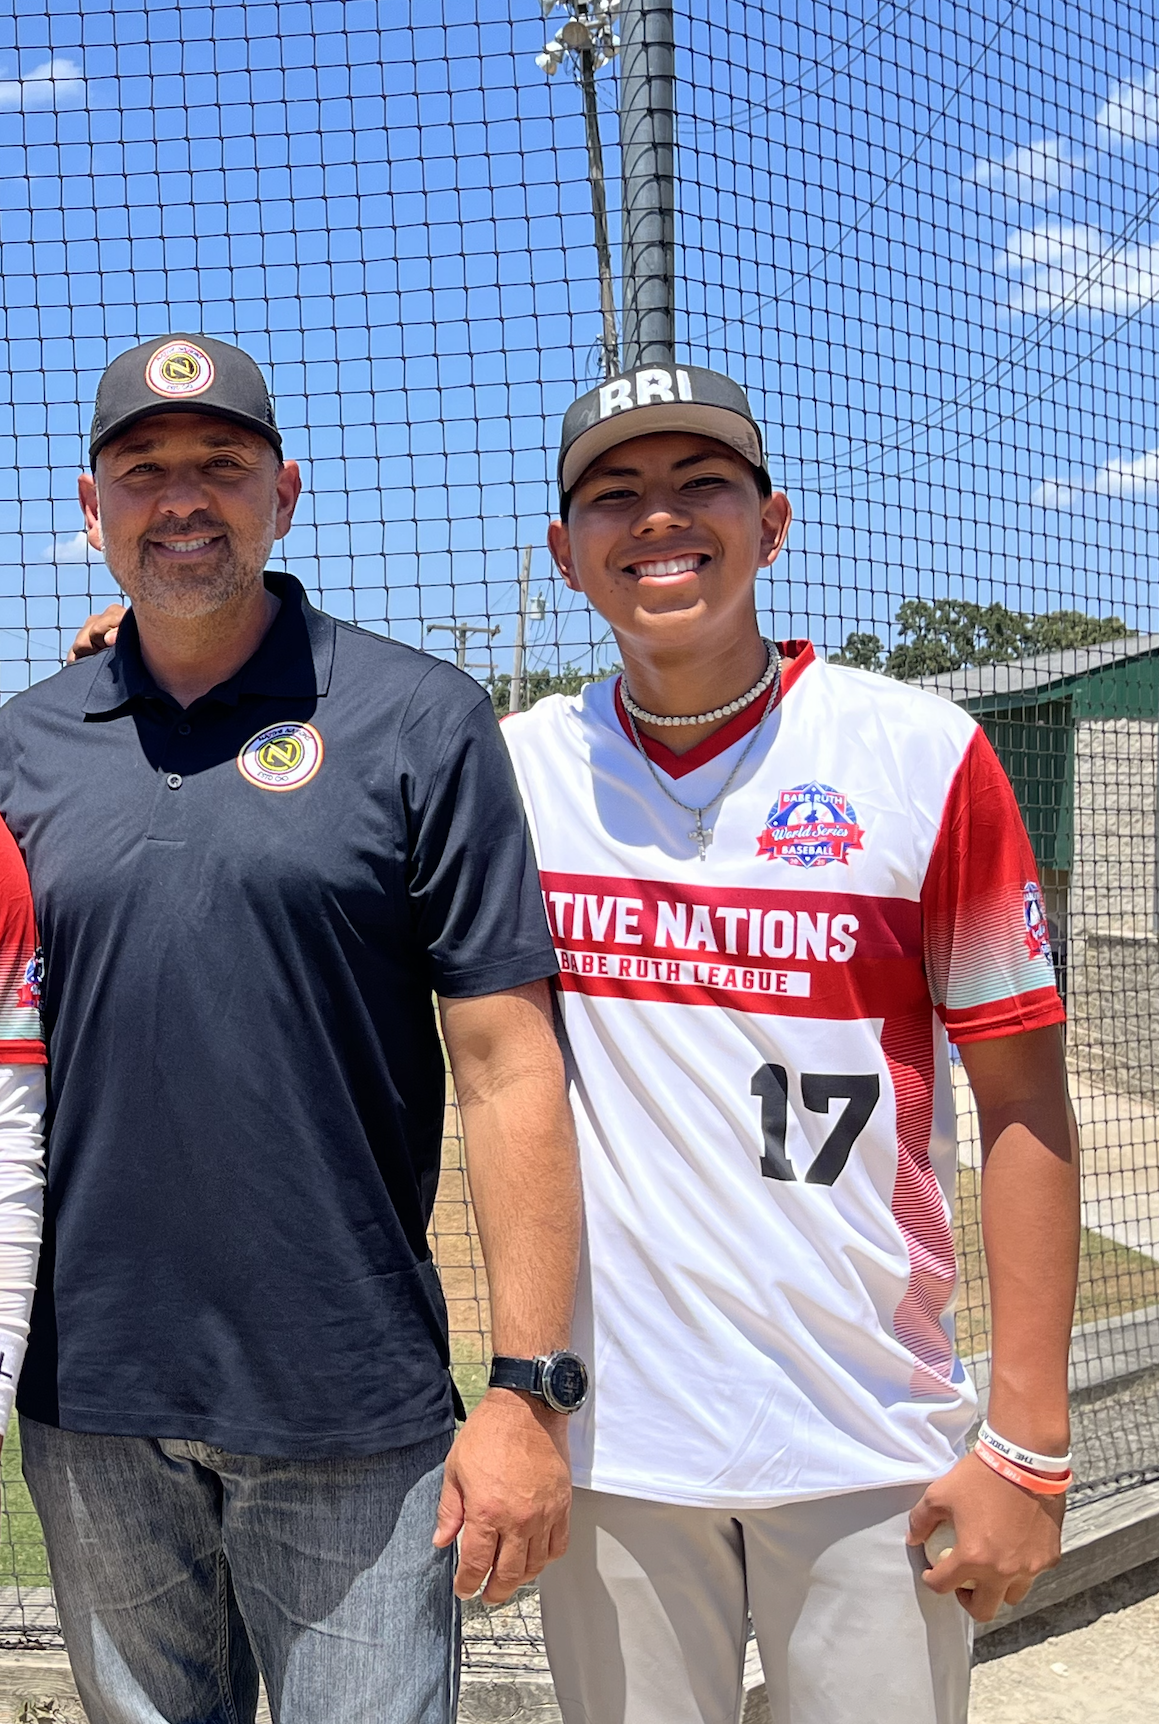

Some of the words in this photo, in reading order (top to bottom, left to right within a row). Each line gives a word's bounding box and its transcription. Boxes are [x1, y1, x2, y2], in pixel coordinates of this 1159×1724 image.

[783, 793, 811, 803] BABE
[813, 794, 843, 804] RUTH
[771, 825, 812, 840] World
[812, 824, 848, 837] Series
[781, 845, 834, 855] BASEBALL
[541, 889, 643, 945] TIVE
[654, 900, 859, 963] NATIONS
[561, 951, 608, 975] BABE
[618, 957, 681, 982] RUTH
[693, 964, 788, 992] LEAGUE
[750, 1063, 880, 1187] 17
[1014, 1452, 1034, 1465] THE
[1003, 1466, 1021, 1481] THE
